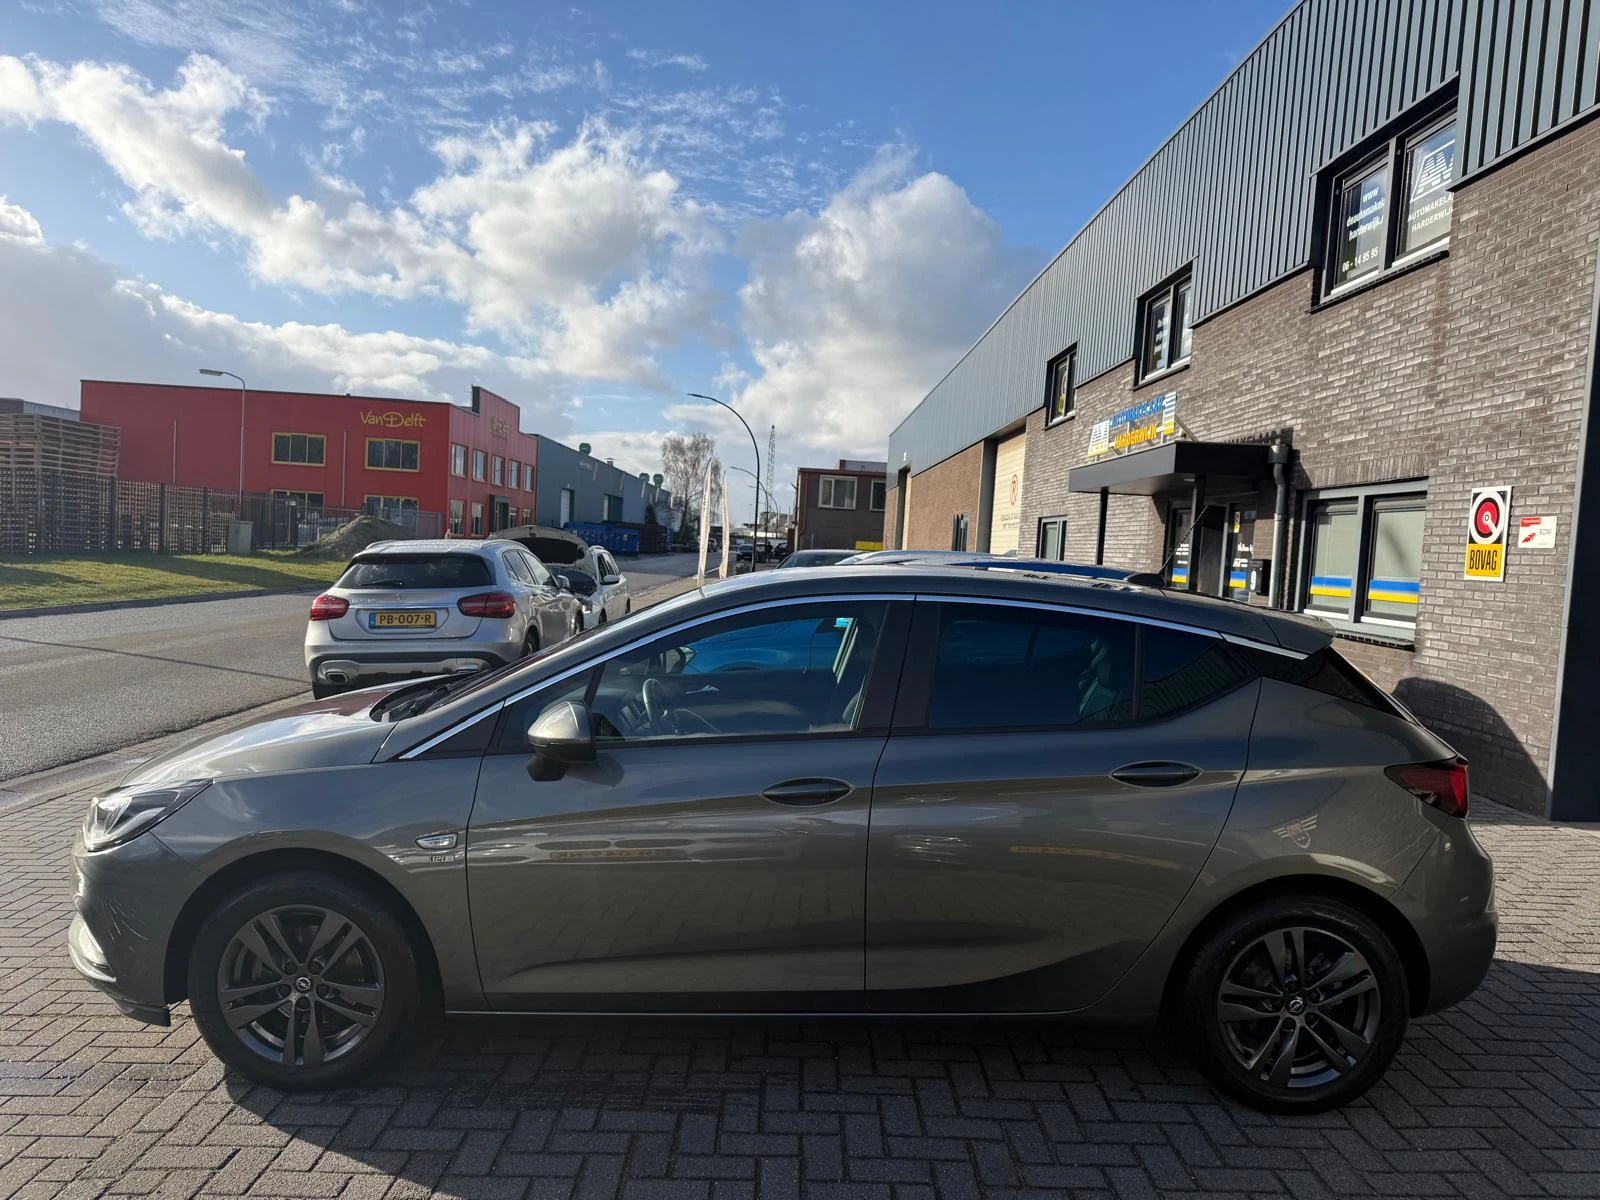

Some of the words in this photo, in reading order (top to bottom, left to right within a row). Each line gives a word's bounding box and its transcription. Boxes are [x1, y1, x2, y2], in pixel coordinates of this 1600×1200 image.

[1362, 187, 1379, 203] www
[1407, 191, 1454, 222] AUTOMAKELA
[1469, 549, 1498, 571] BOVAG
[379, 614, 432, 625] PB-007-R
